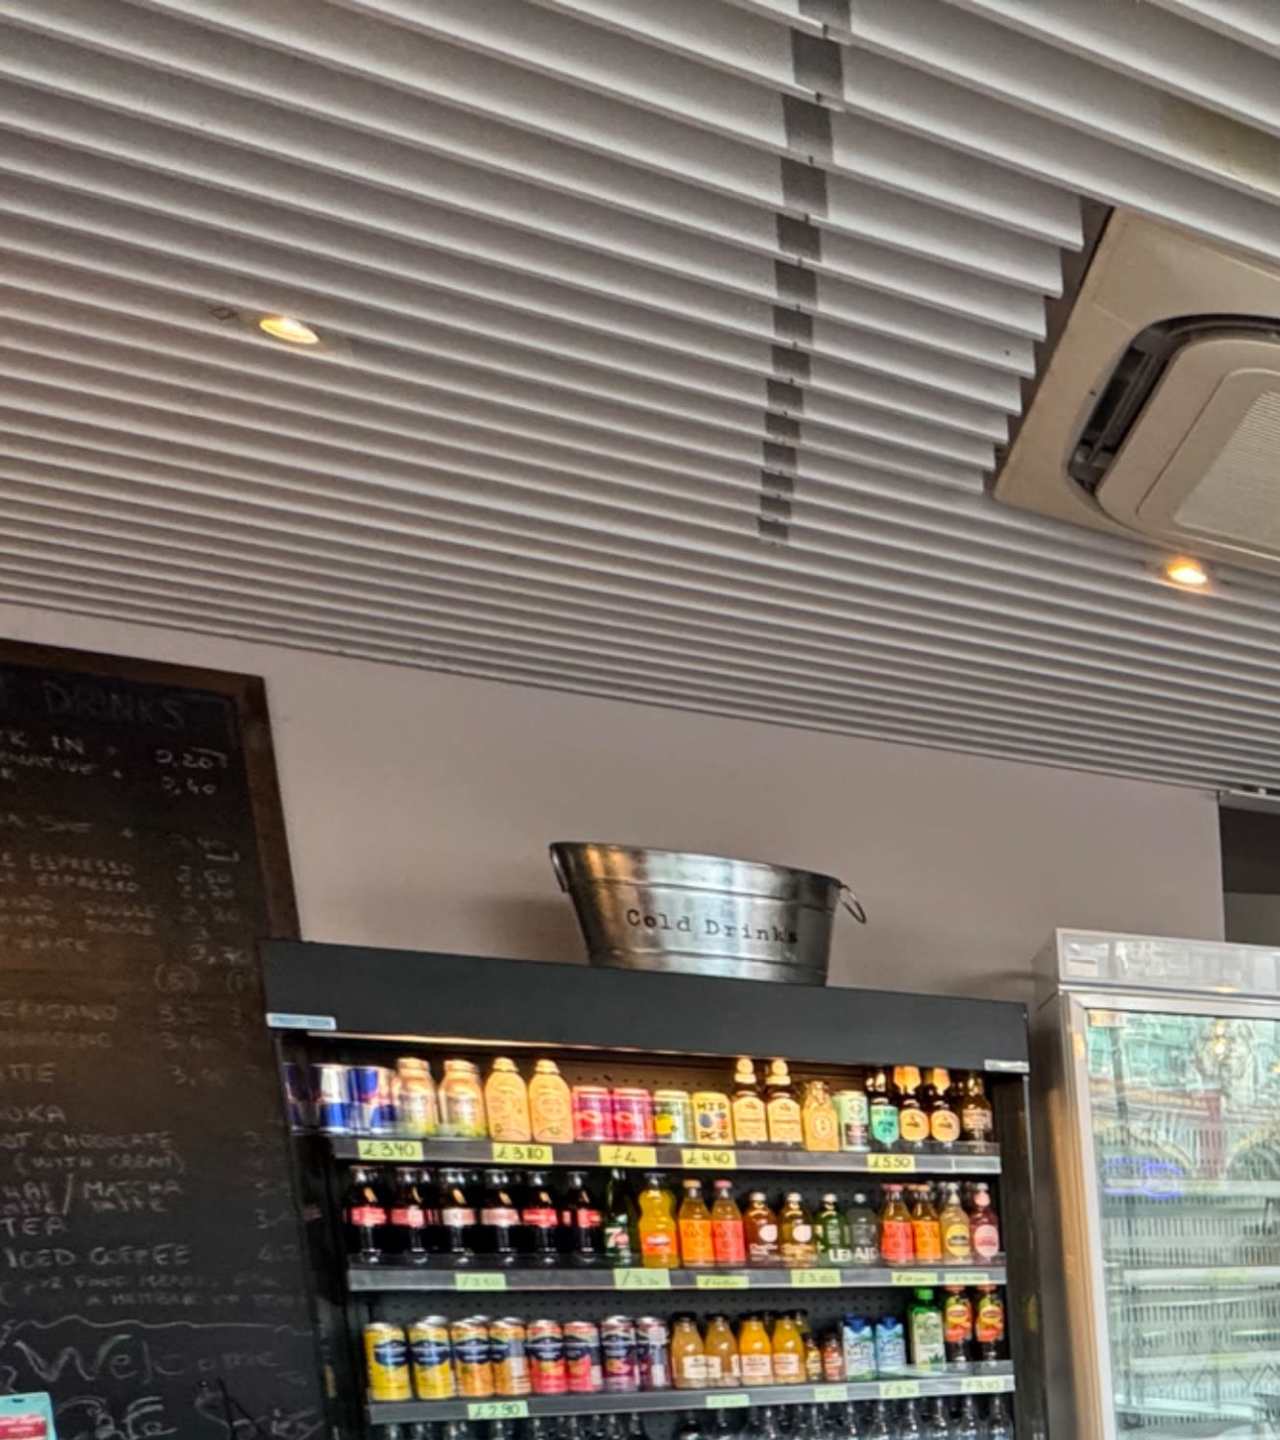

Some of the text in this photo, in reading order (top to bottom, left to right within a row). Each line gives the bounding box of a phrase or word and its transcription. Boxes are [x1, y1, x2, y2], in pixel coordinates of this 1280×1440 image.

[627, 909, 798, 944] Cold Drinks
[0, 1217, 69, 1238] TEA
[3, 1246, 77, 1269] ICED
[89, 1243, 192, 1266] COFFEE
[13, 1332, 281, 1385] Welcome
